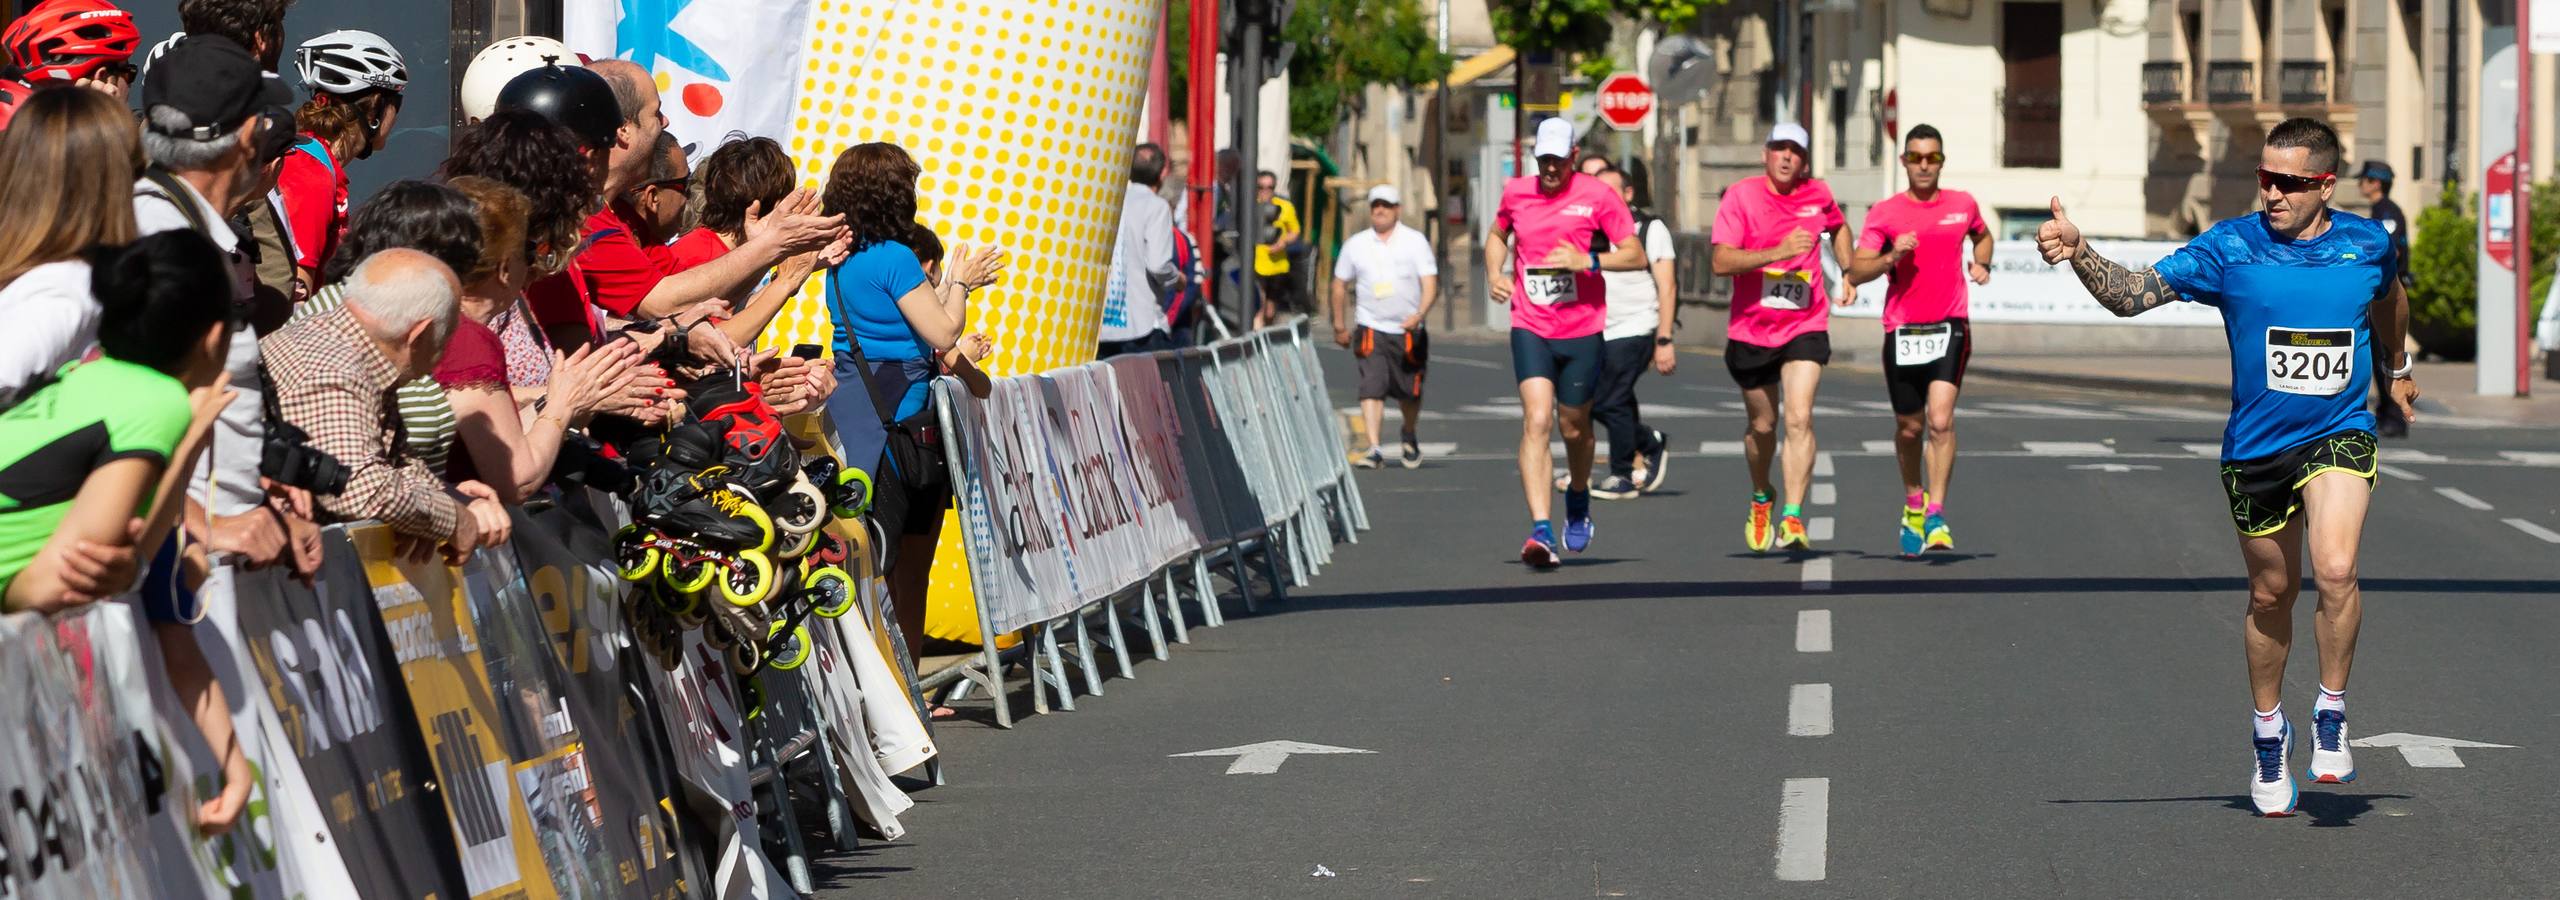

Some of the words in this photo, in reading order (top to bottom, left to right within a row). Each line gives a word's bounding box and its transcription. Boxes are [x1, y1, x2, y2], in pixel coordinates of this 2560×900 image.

[1603, 92, 1650, 110] STOP
[1770, 283, 1804, 300] 479
[1900, 338, 1945, 356] 3191
[2271, 350, 2349, 380] 3204
